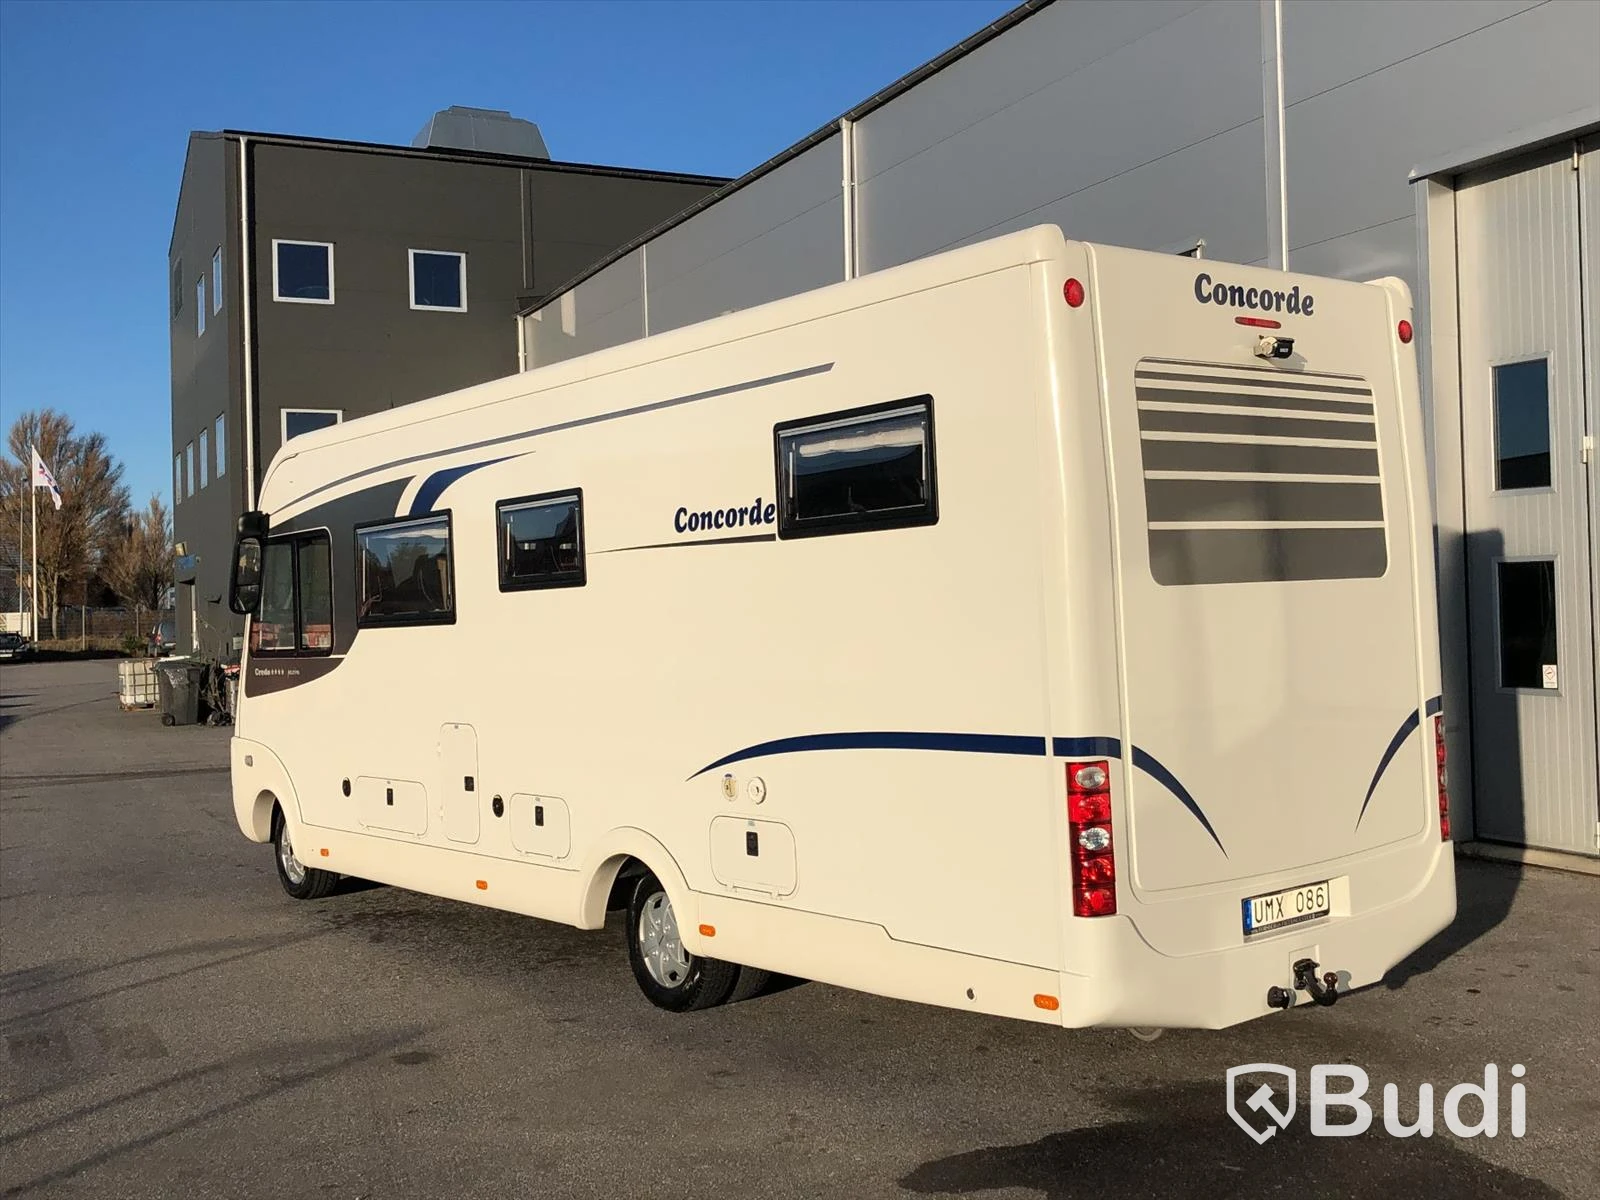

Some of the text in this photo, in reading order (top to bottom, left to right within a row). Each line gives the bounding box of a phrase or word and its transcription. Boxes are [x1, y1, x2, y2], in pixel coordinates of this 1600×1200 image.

[1194, 272, 1314, 317] Concorde
[674, 497, 776, 534] Concorde
[1254, 895, 1284, 924] UMX
[1296, 886, 1325, 913] 086
